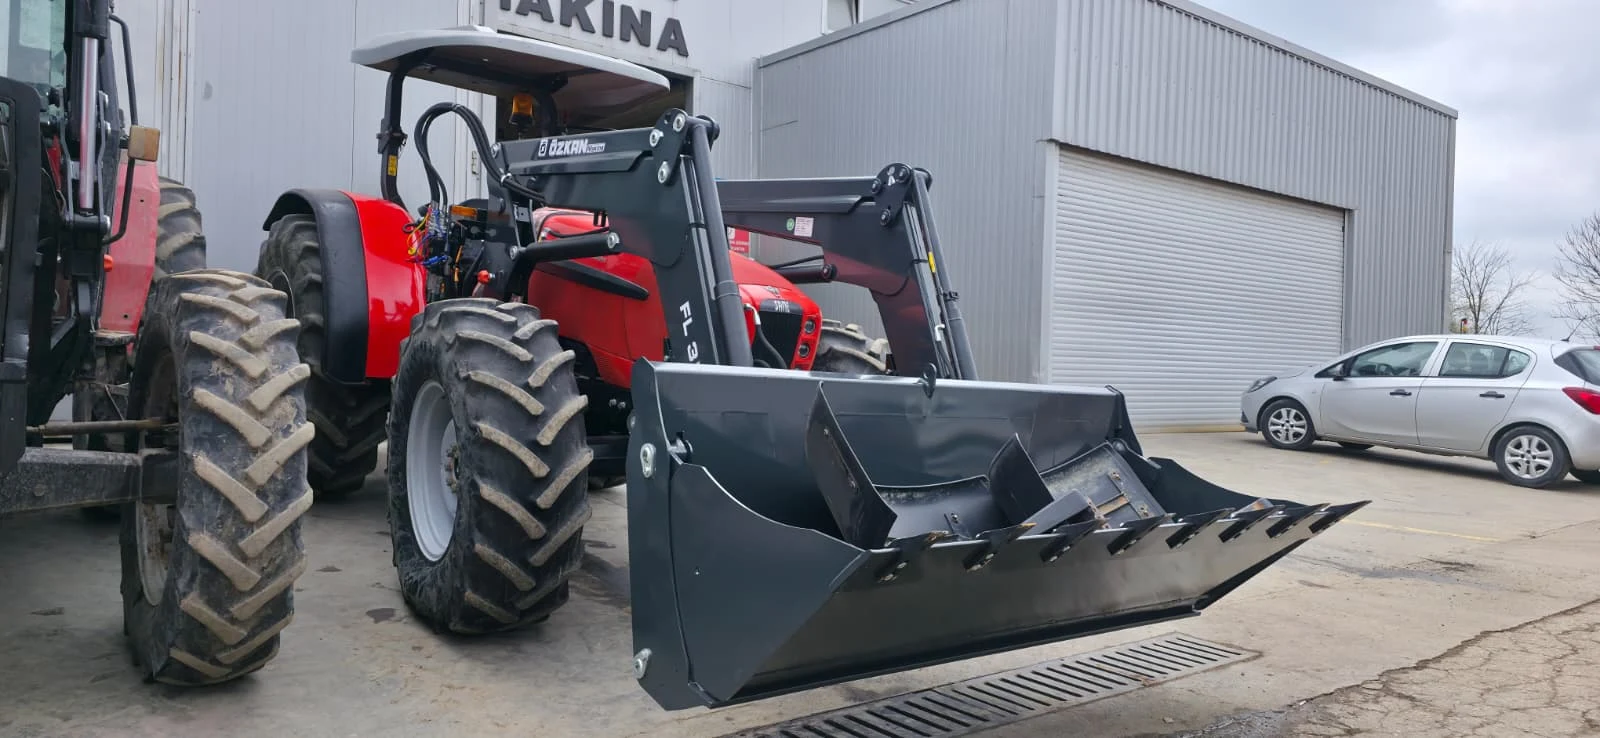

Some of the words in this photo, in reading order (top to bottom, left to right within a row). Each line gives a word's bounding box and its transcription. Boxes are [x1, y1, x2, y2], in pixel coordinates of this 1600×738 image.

[500, 0, 689, 57] AKINA
[548, 138, 589, 157] ÖZKAN
[679, 300, 693, 337] FL
[687, 341, 701, 365] 3
